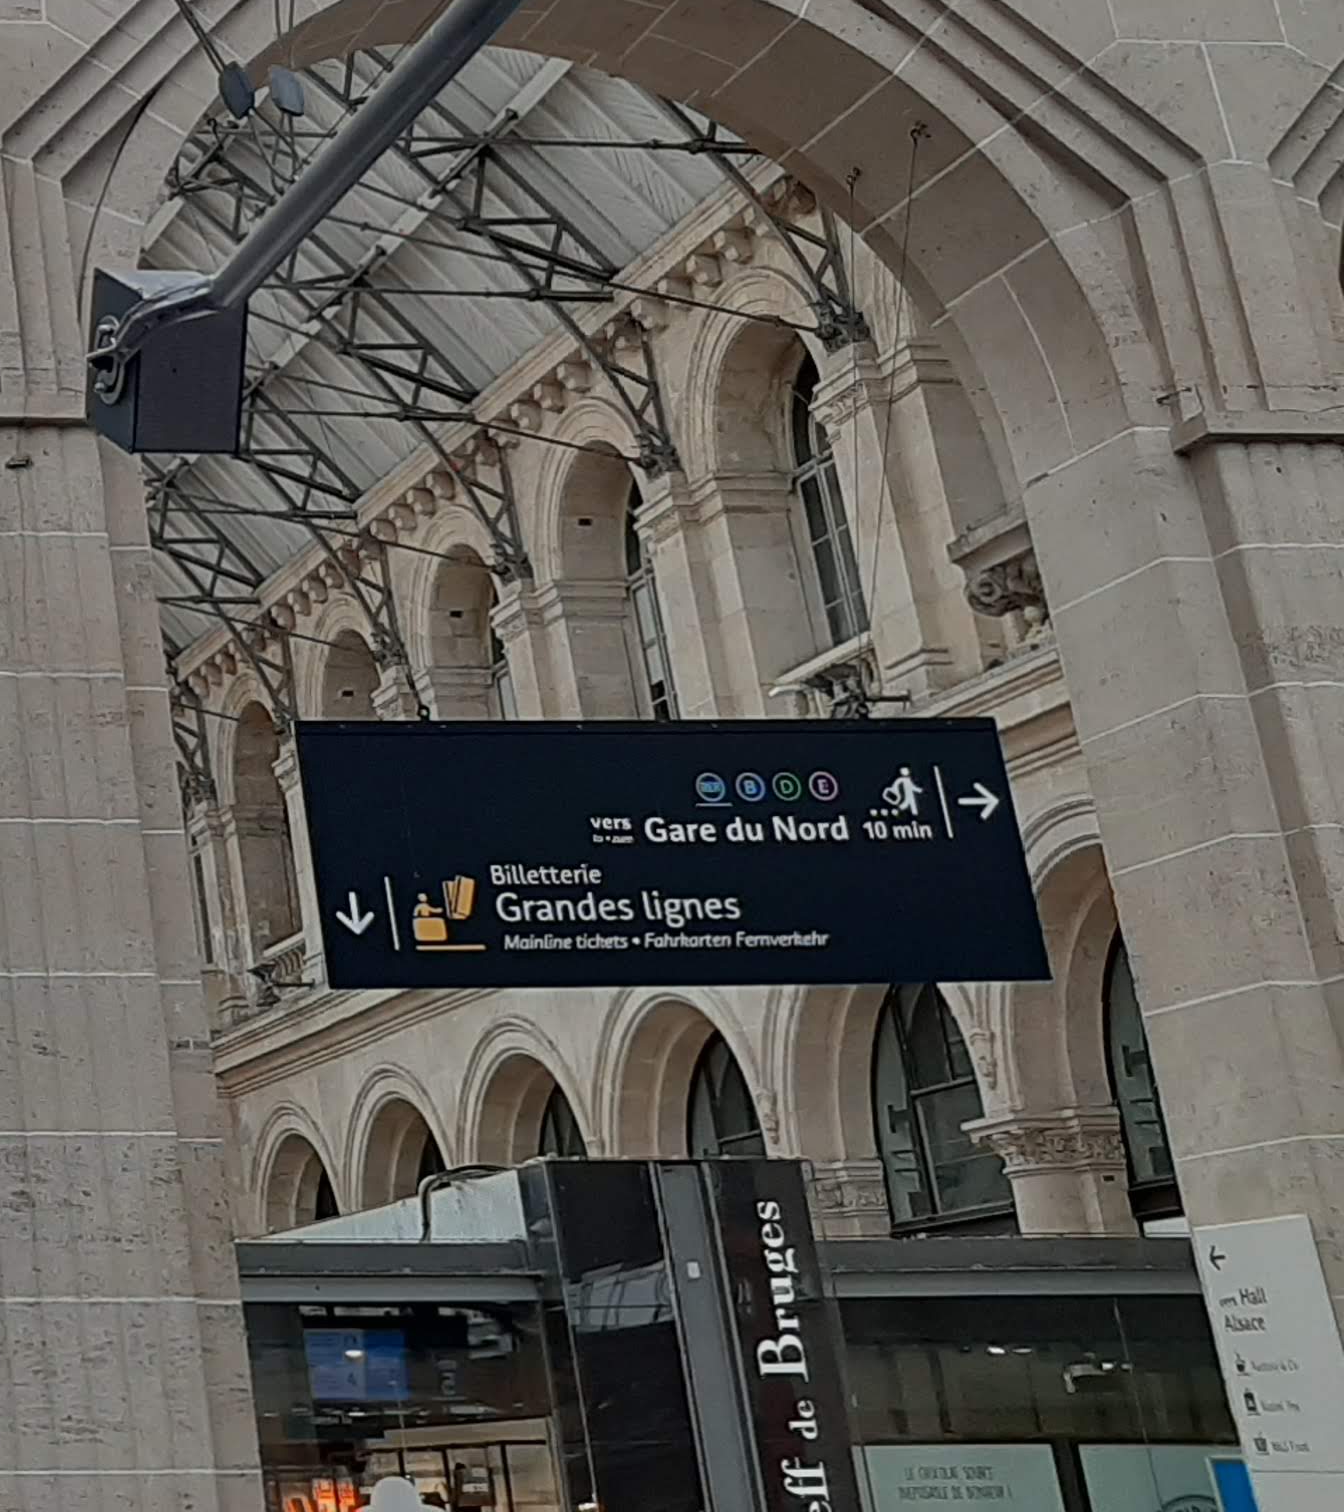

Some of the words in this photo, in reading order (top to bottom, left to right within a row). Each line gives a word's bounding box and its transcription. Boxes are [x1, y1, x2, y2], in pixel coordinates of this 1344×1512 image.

[590, 816, 632, 830] vers
[643, 816, 717, 842] Gare
[725, 816, 762, 841] du
[772, 815, 850, 841] Nord
[862, 821, 886, 840] 10
[893, 821, 933, 839] min
[490, 863, 603, 885] Billetterie
[496, 891, 634, 922] Grandes
[641, 890, 742, 928] lignes
[503, 933, 573, 951] Mainline
[576, 933, 629, 950] tickets
[644, 932, 731, 949] Fahrkarten
[735, 930, 830, 948] Fernverkehr
[756, 1199, 810, 1383] Bruges
[1238, 1287, 1269, 1306] Hall
[788, 1399, 818, 1440] de
